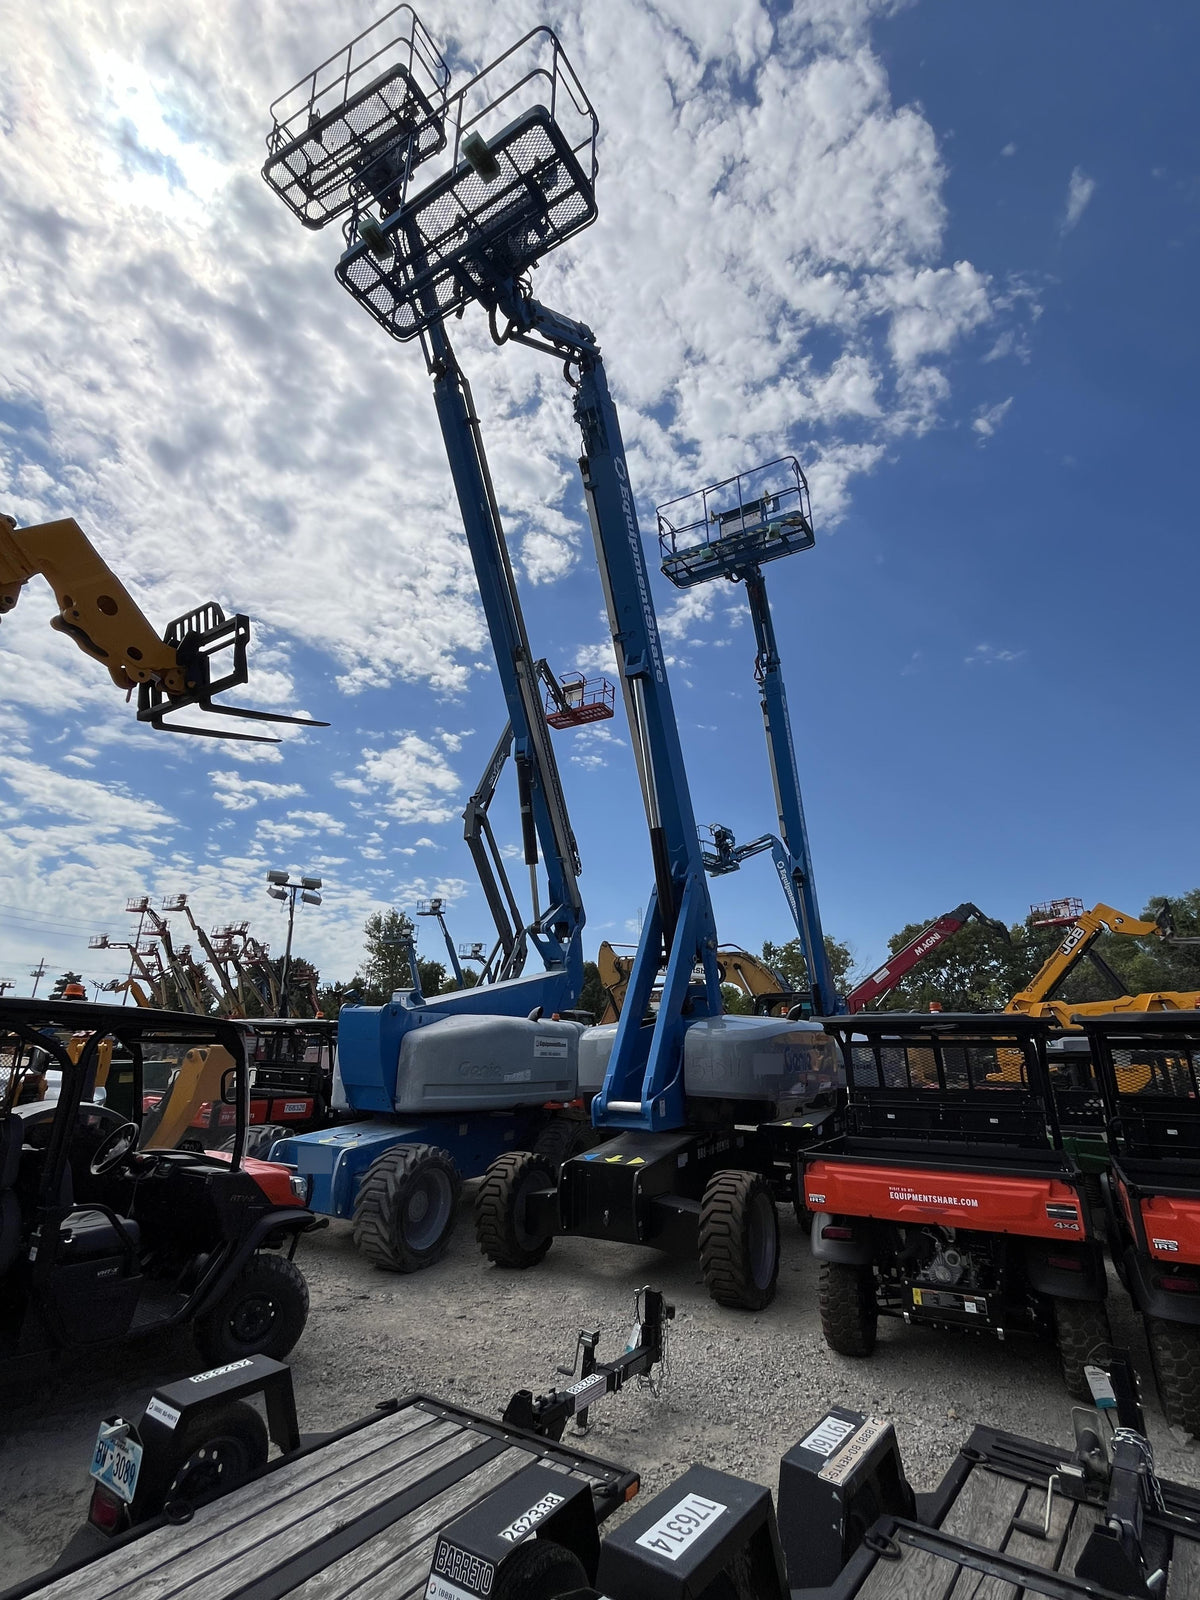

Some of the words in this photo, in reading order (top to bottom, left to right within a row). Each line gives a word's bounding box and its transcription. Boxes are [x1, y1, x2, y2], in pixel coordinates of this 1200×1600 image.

[619, 484, 664, 684] EquipmentShare
[914, 932, 942, 956] MAGNI
[1062, 927, 1086, 955] JCB
[889, 1191, 979, 1207] EQUIPMENTSHARE.COM
[1054, 1221, 1080, 1231] 4x4
[1154, 1243, 1179, 1251] IRS
[807, 1420, 852, 1454] 191160
[858, 1426, 877, 1445] (888)
[113, 1452, 136, 1487] 3089
[502, 1496, 560, 1541] 262338
[646, 1499, 717, 1553] 176314
[435, 1540, 495, 1595] BARRETO
